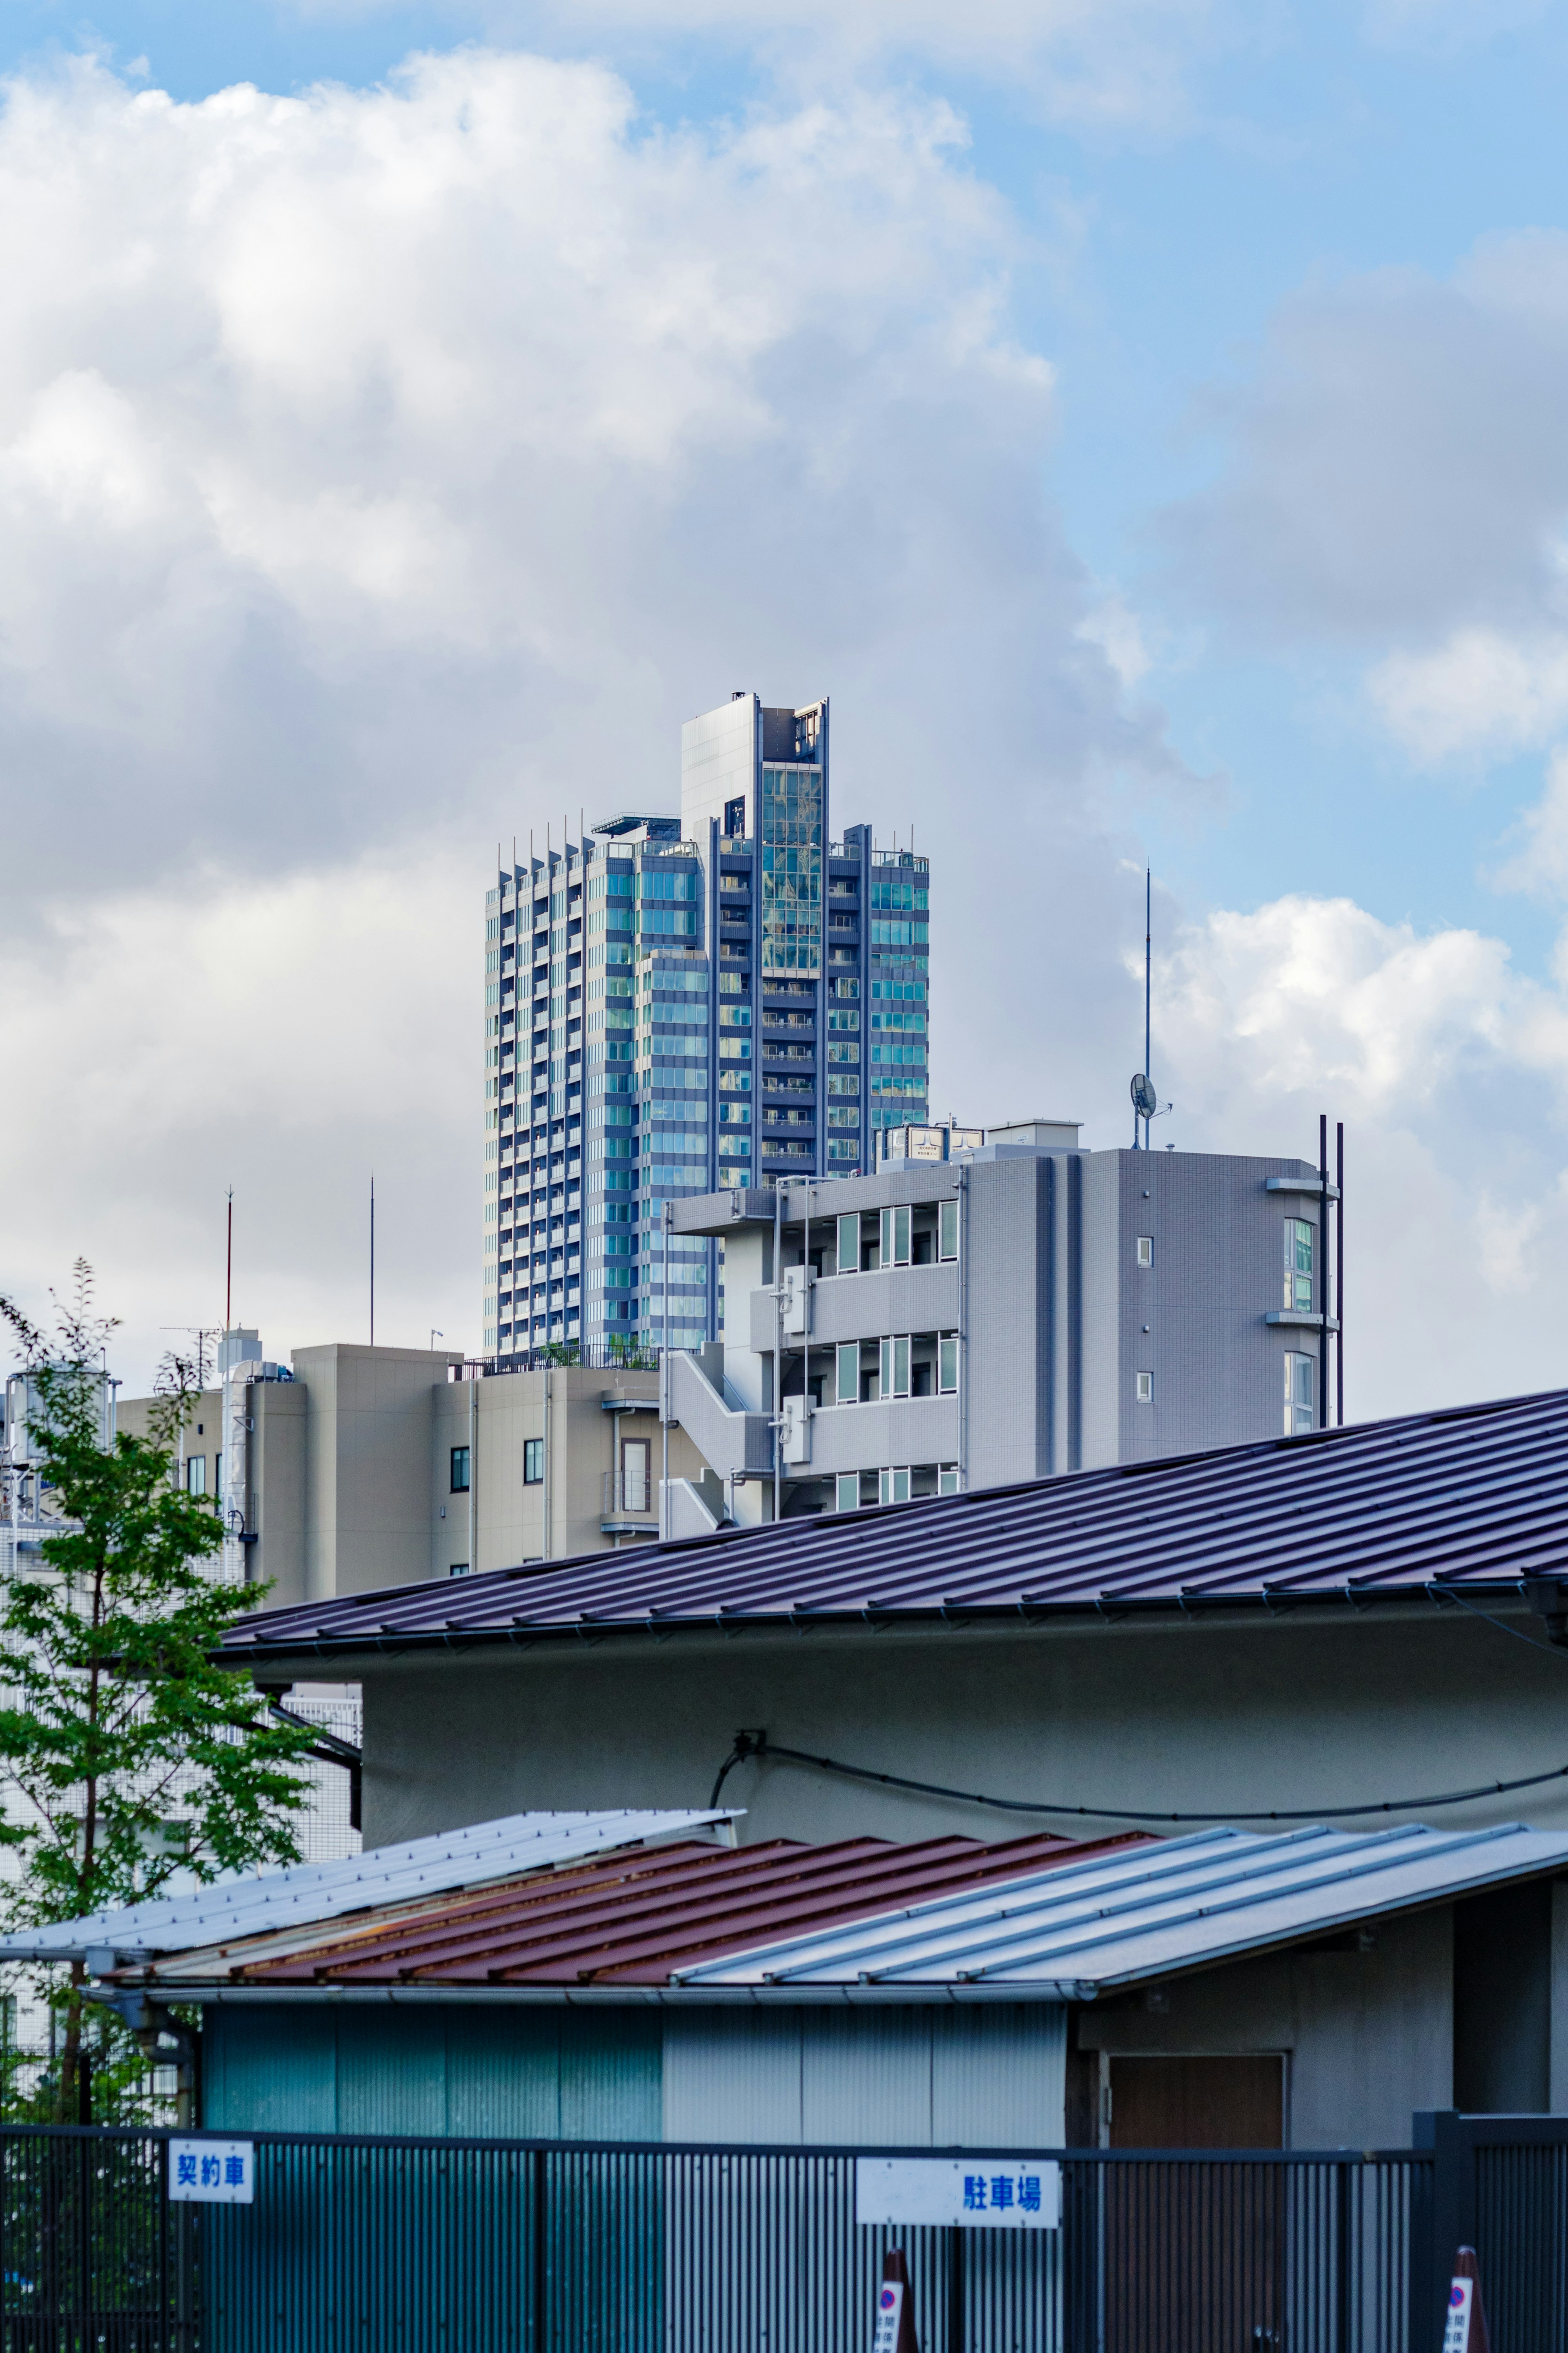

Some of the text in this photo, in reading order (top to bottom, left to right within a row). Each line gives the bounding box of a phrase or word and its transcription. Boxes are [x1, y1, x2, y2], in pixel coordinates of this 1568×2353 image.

[178, 2154, 244, 2187] 契約車
[963, 2175, 1041, 2212] 駐車場
